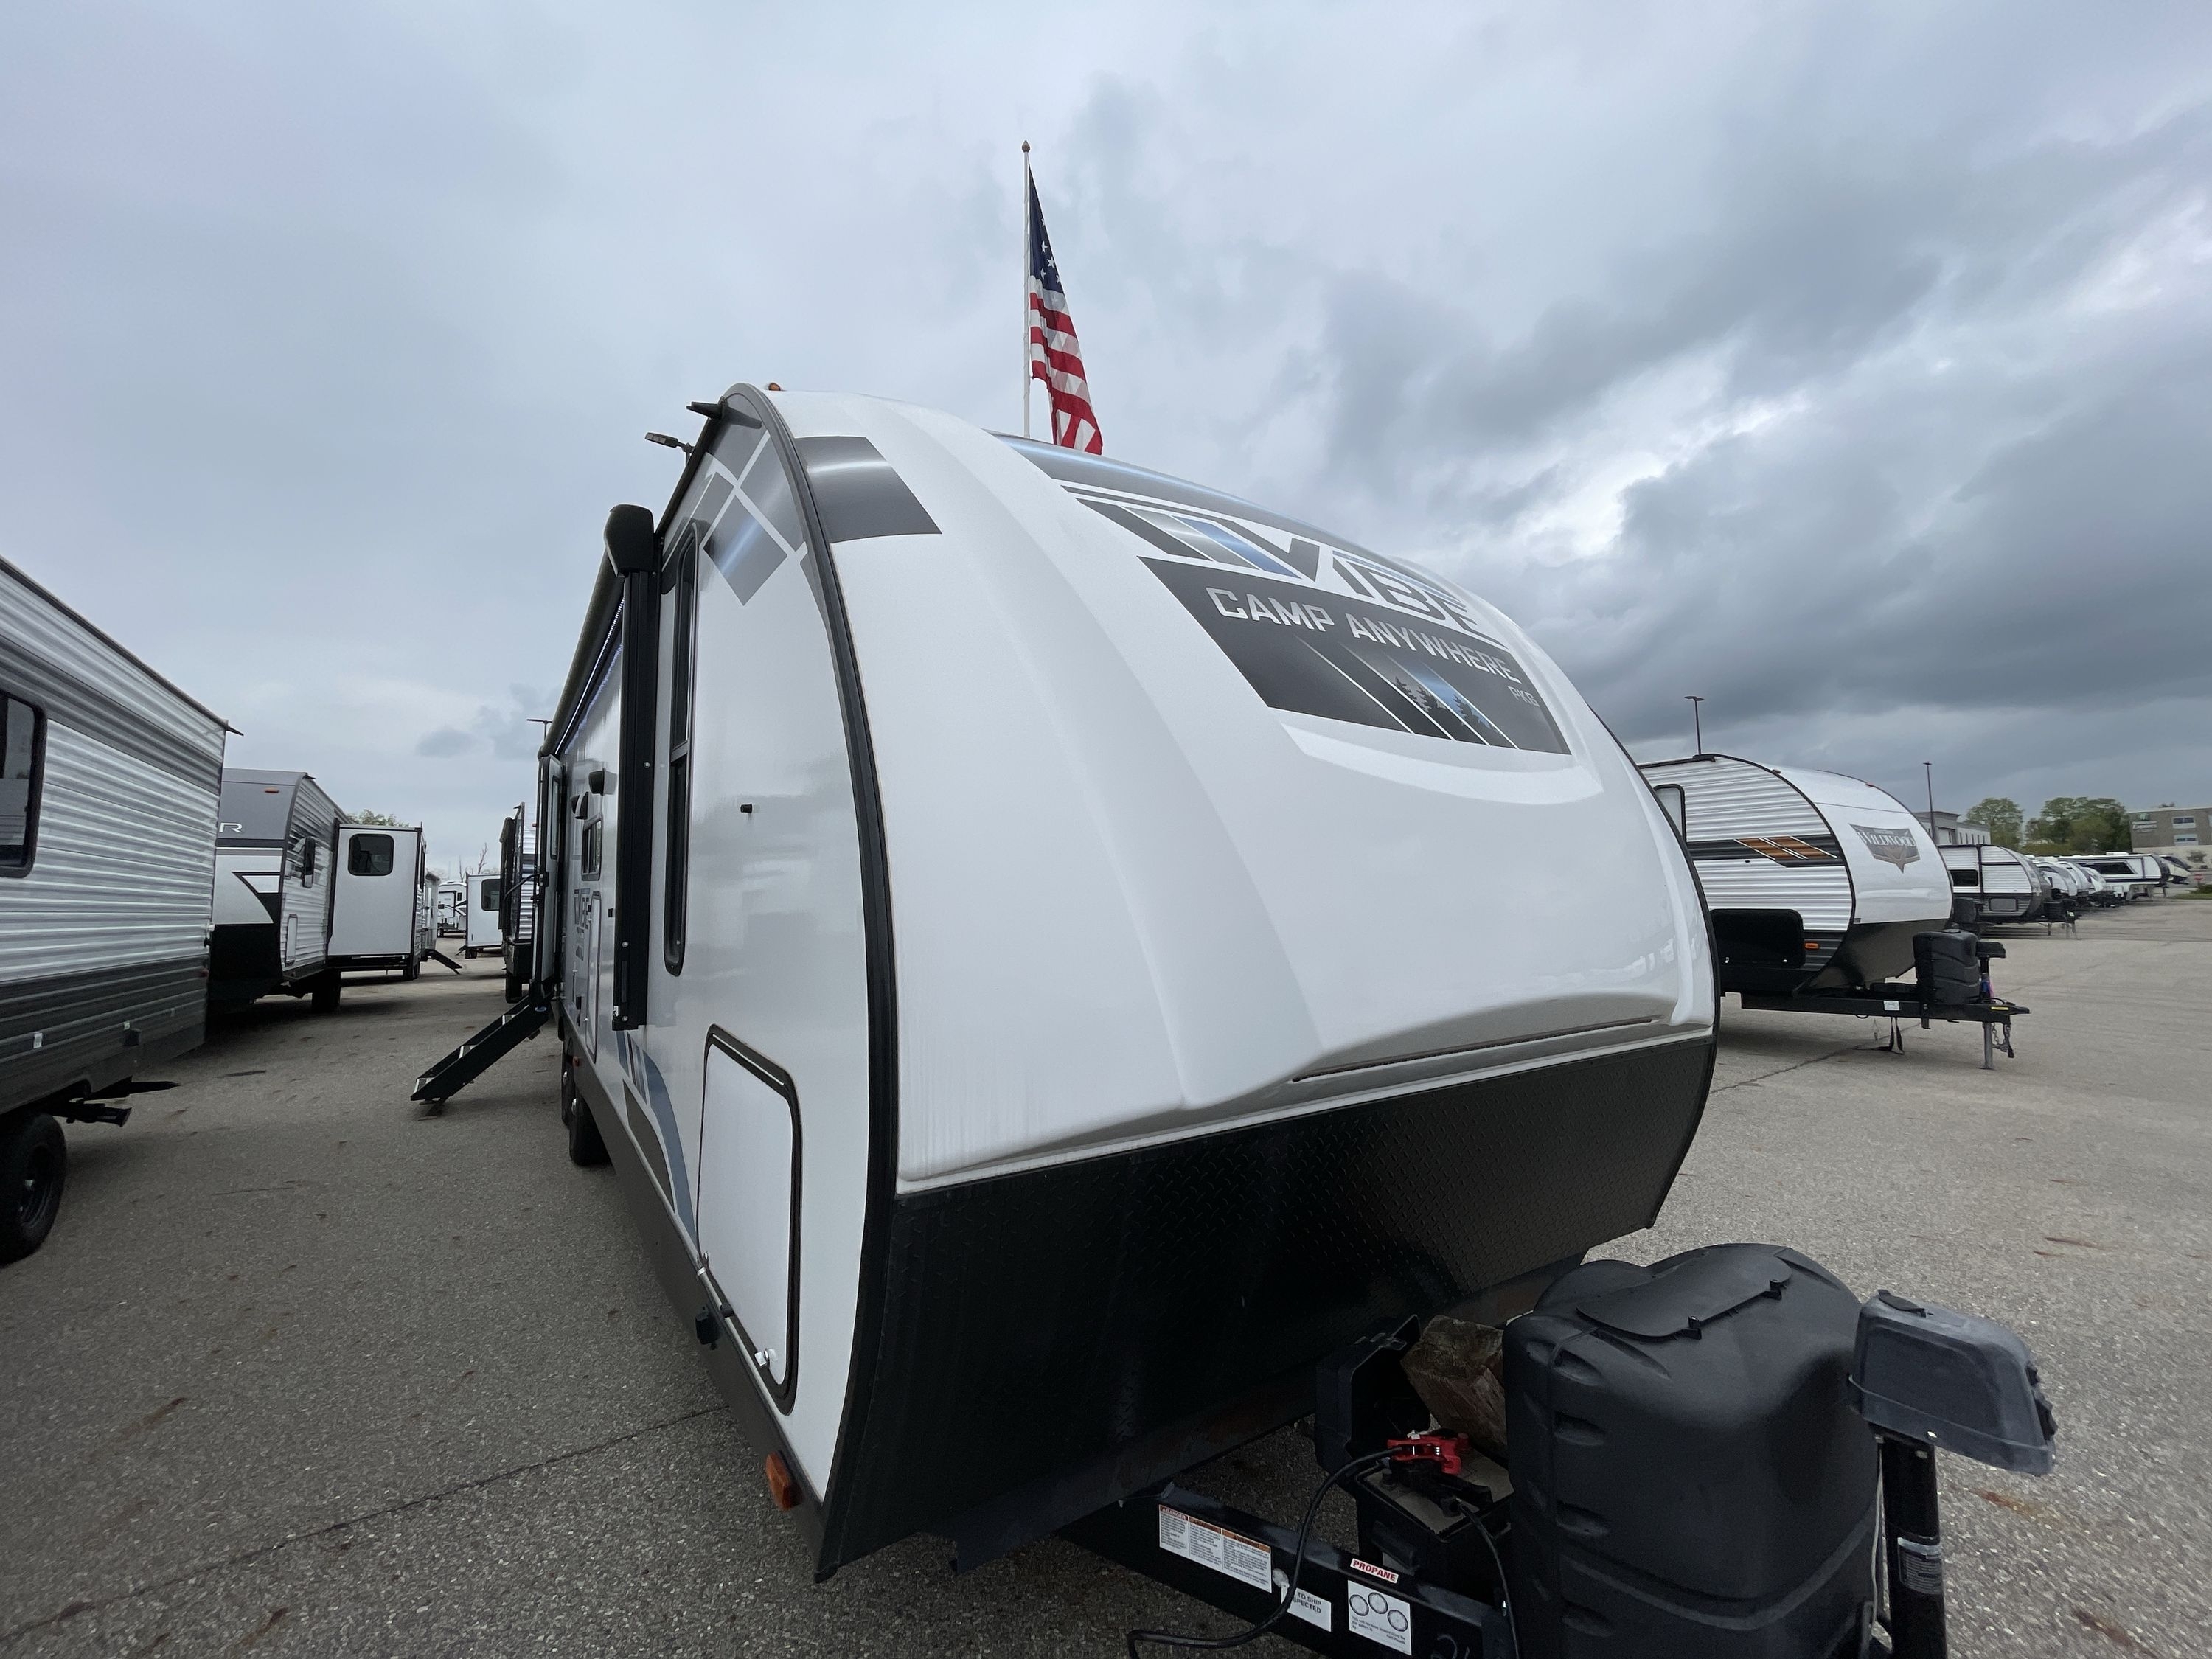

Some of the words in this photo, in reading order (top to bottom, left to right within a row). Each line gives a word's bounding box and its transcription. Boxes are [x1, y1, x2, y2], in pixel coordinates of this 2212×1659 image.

[1205, 587, 1335, 632] CAMP
[1345, 613, 1523, 684] ANYWHERE
[1506, 685, 1540, 707] PKG
[1857, 832, 1917, 846] WILDWOOD
[1352, 1559, 1397, 1582] PROPANE
[1293, 1596, 1321, 1613] SPECTED
[1297, 1591, 1307, 1601] TO
[1307, 1596, 1322, 1607] SHIP
